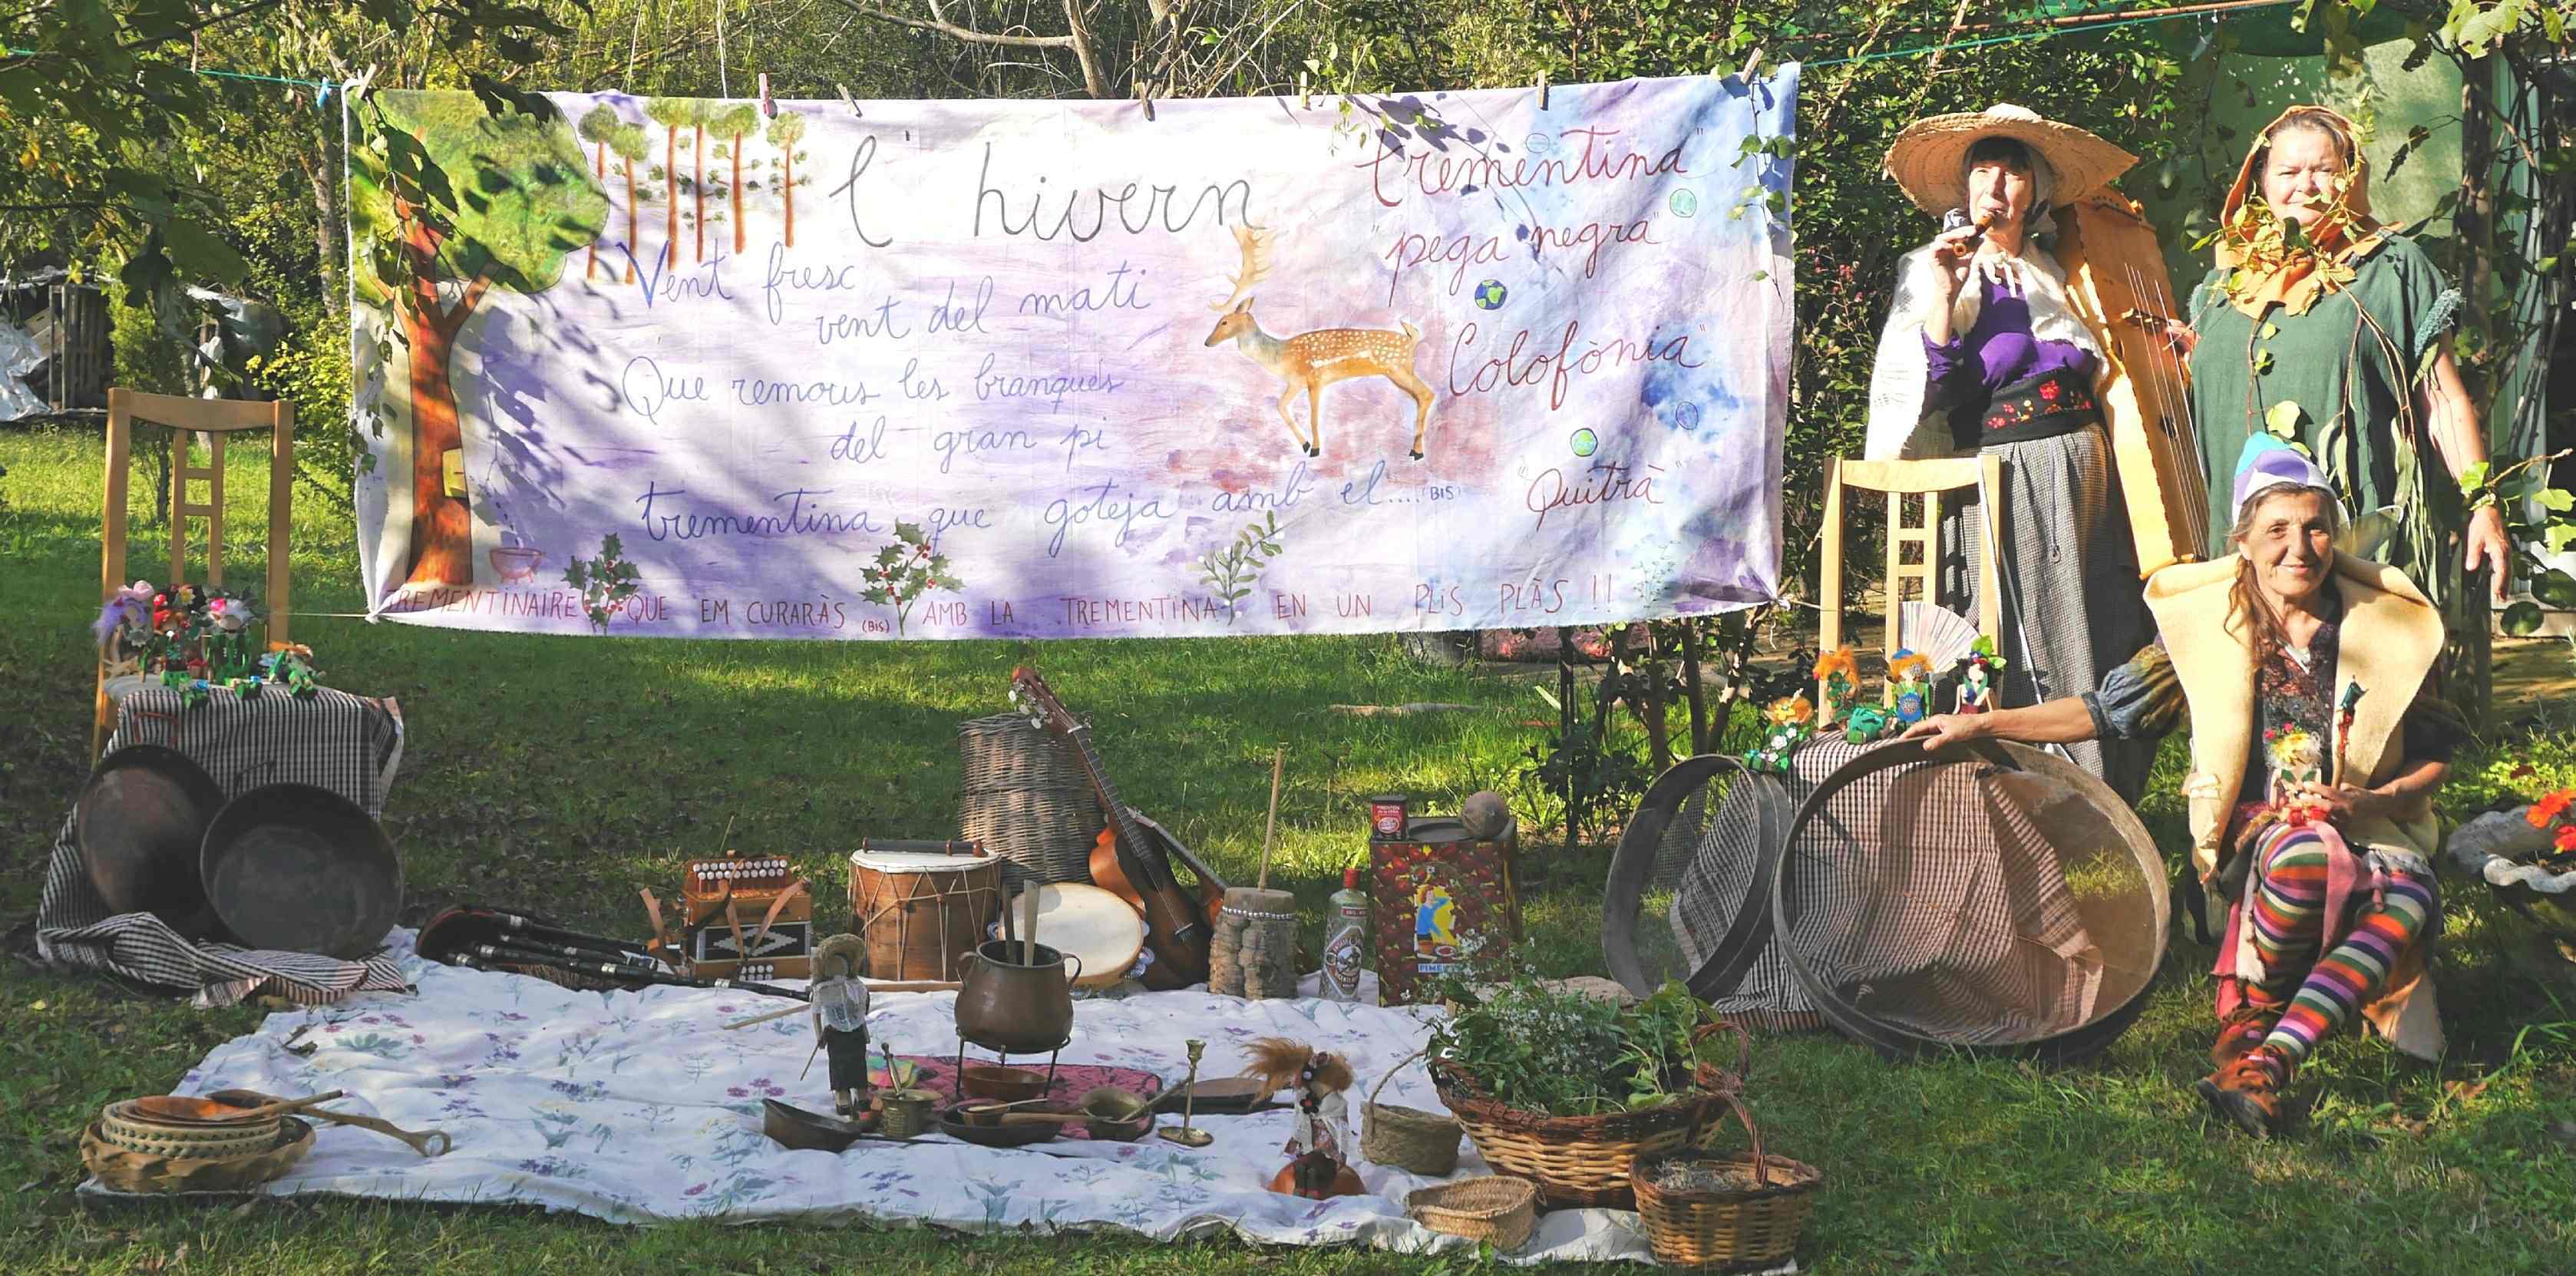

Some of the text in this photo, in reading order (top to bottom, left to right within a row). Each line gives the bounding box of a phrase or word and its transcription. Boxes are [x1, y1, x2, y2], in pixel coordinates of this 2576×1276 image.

[973, 141, 1267, 243] hivern
[615, 237, 855, 326] Vent fresc
[816, 295, 911, 345] vent
[929, 276, 994, 335] del
[622, 355, 709, 425] Que
[898, 358, 949, 401] les
[975, 352, 1125, 414] branques
[830, 416, 1110, 474] del gran pi
[636, 481, 883, 541] trementina
[928, 507, 992, 558] que
[1044, 478, 1178, 557] goteja
[1211, 461, 1315, 512] amb
[626, 594, 671, 626] QUE
[701, 598, 731, 625] EM
[746, 593, 846, 629] CURARÀS
[922, 601, 968, 626] AMB
[991, 600, 1014, 626] LA
[1276, 592, 1307, 620] EN
[1336, 593, 1372, 617] UN
